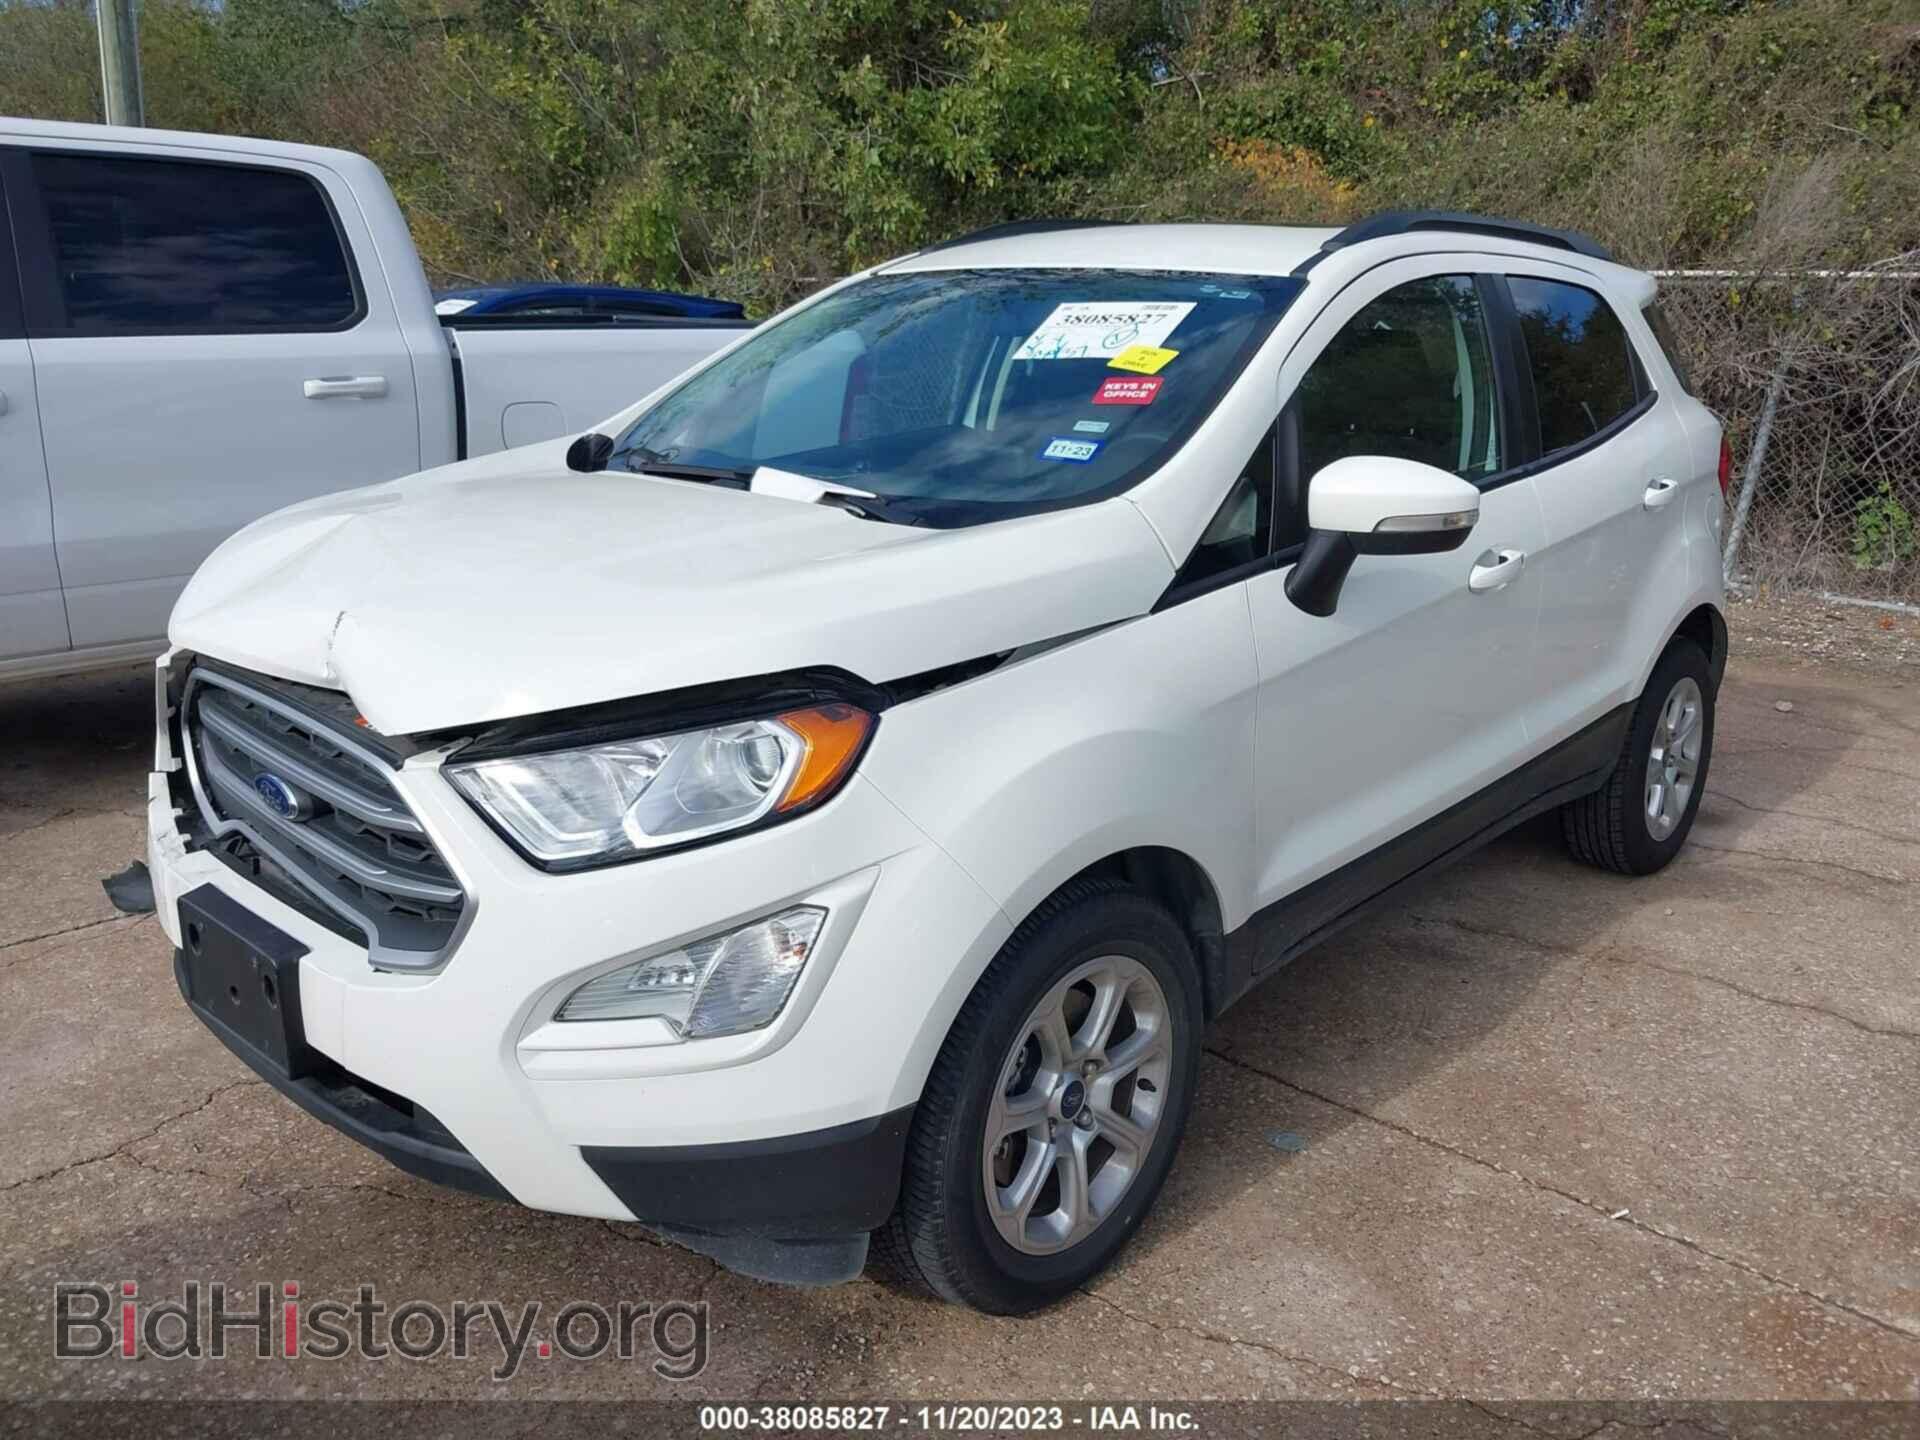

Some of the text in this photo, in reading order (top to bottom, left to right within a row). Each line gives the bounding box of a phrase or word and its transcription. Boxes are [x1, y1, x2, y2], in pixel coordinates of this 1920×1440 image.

[1056, 313, 1169, 326] 38085827
[1104, 382, 1157, 390] KEYS IN
[1103, 390, 1148, 398] OFFICE
